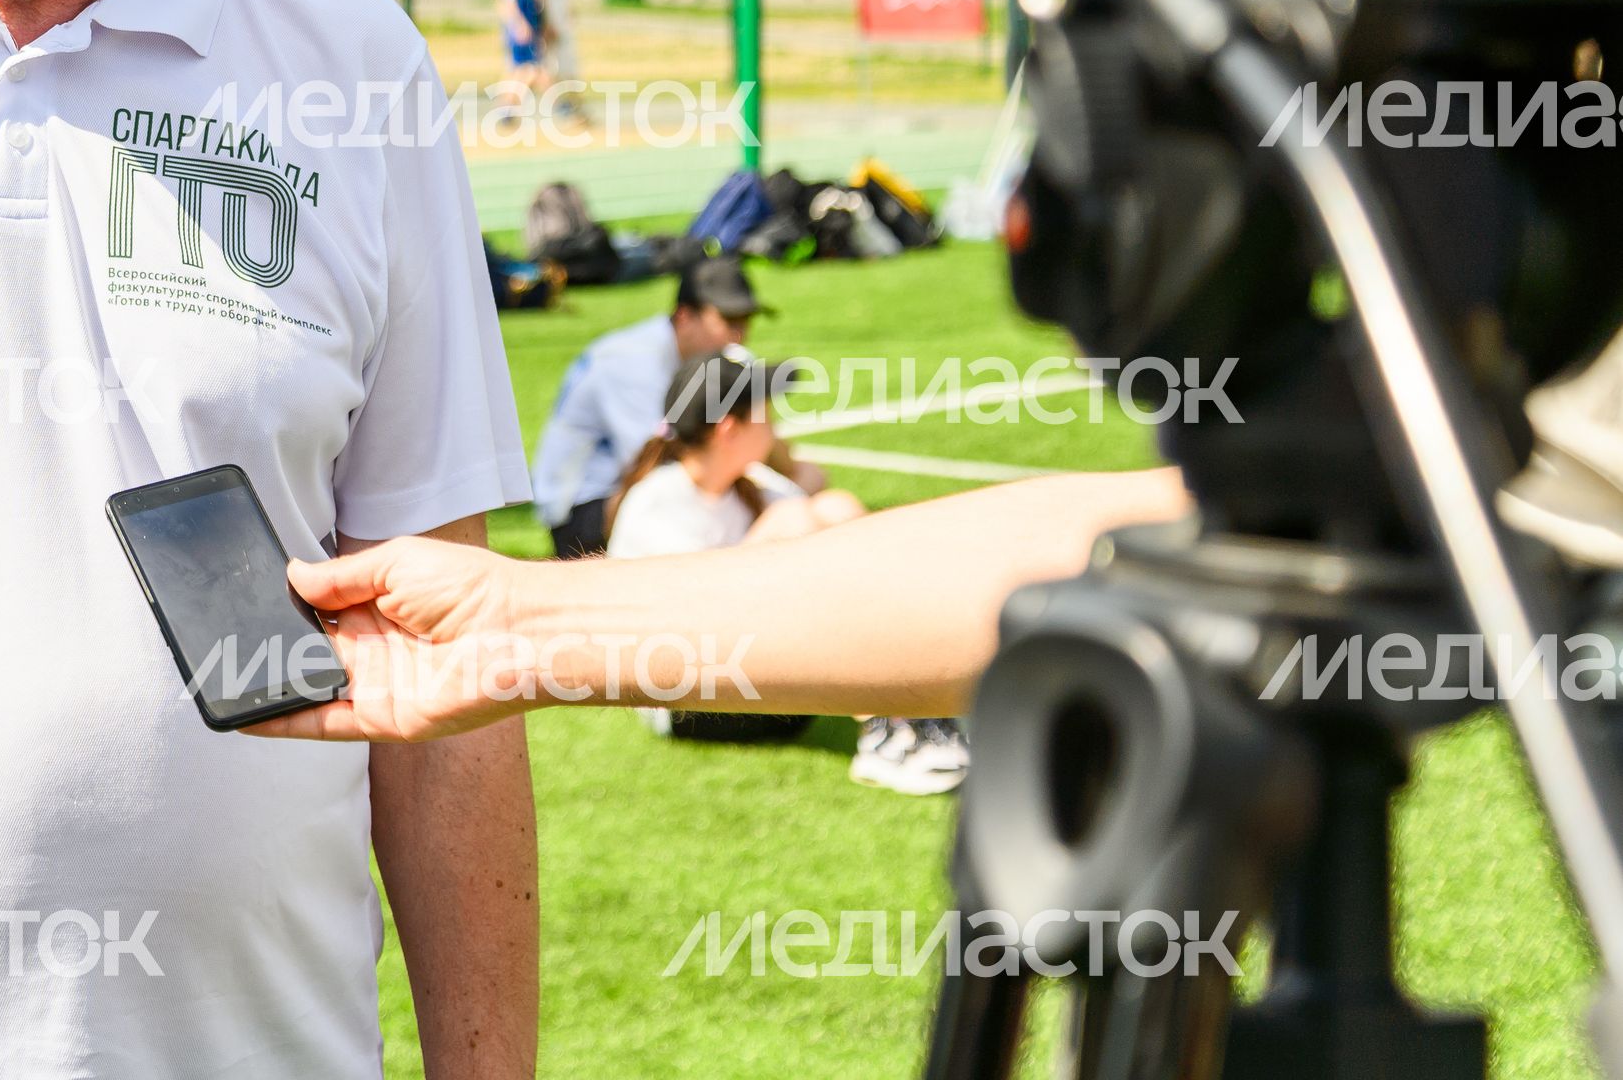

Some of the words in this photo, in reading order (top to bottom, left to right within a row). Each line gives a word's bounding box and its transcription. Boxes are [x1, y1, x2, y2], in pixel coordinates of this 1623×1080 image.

[108, 146, 298, 289] ГТО
[108, 267, 207, 288] Всероссийский
[108, 295, 149, 307] «Готов
[154, 300, 162, 308] к
[166, 300, 204, 315] труду
[208, 307, 216, 315] и
[108, 282, 278, 319] физкультурно-спортивный
[281, 313, 333, 336] комплекс
